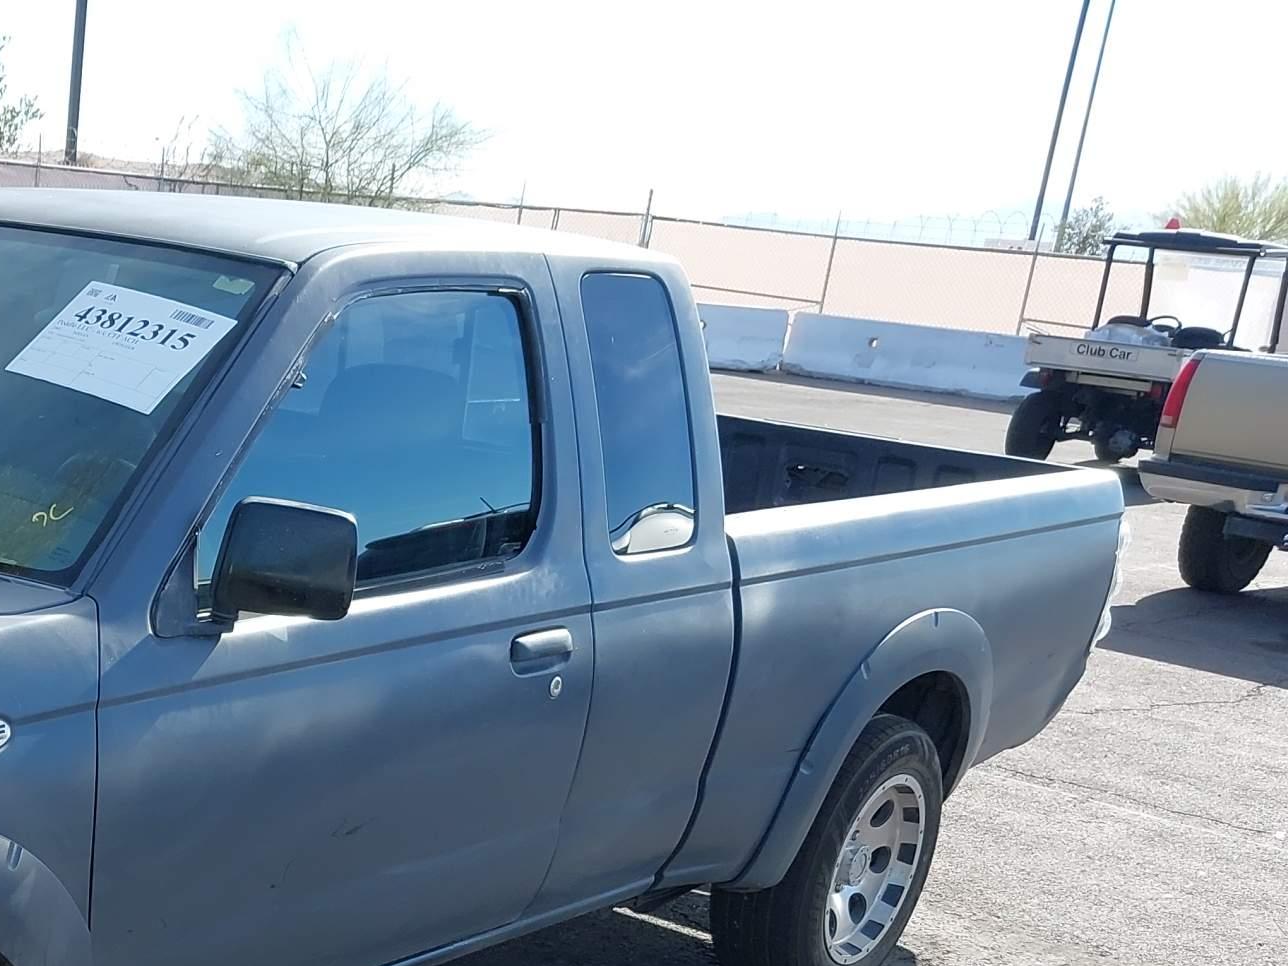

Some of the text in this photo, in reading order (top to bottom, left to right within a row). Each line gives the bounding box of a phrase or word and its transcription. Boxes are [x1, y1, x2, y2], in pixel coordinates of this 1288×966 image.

[75, 306, 196, 350] 43812315
[1076, 343, 1132, 361] Club Car
